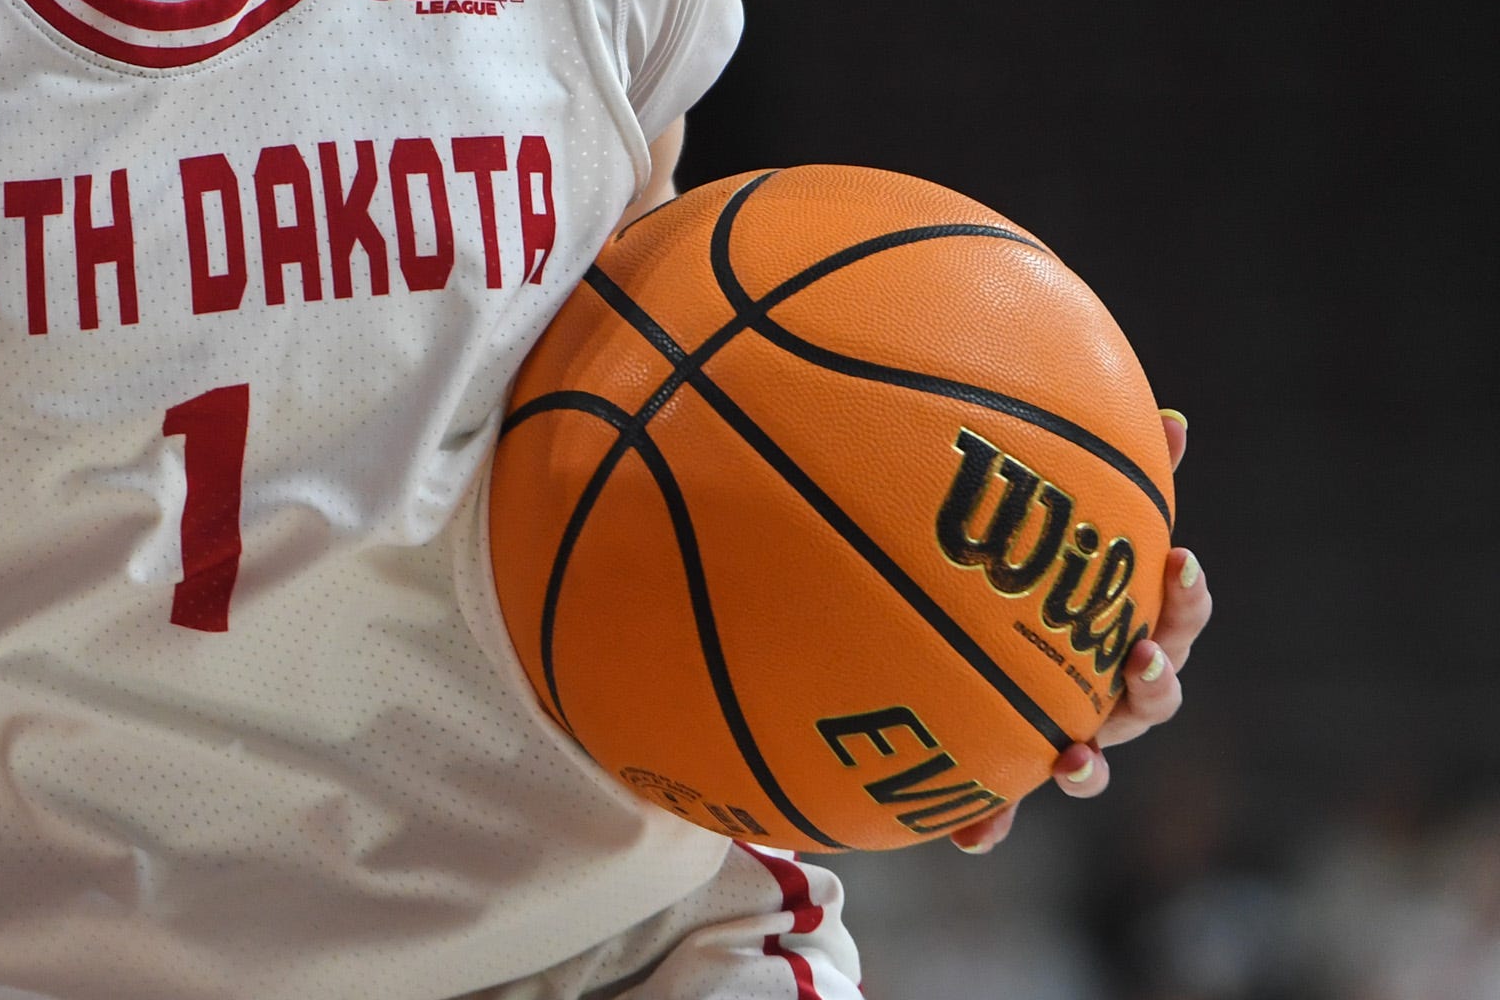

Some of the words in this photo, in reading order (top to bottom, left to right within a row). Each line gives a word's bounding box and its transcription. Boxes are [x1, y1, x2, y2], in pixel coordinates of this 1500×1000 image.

[416, 0, 498, 16] LEAGUE
[179, 135, 557, 315] DAKOTA
[162, 383, 249, 632] 1
